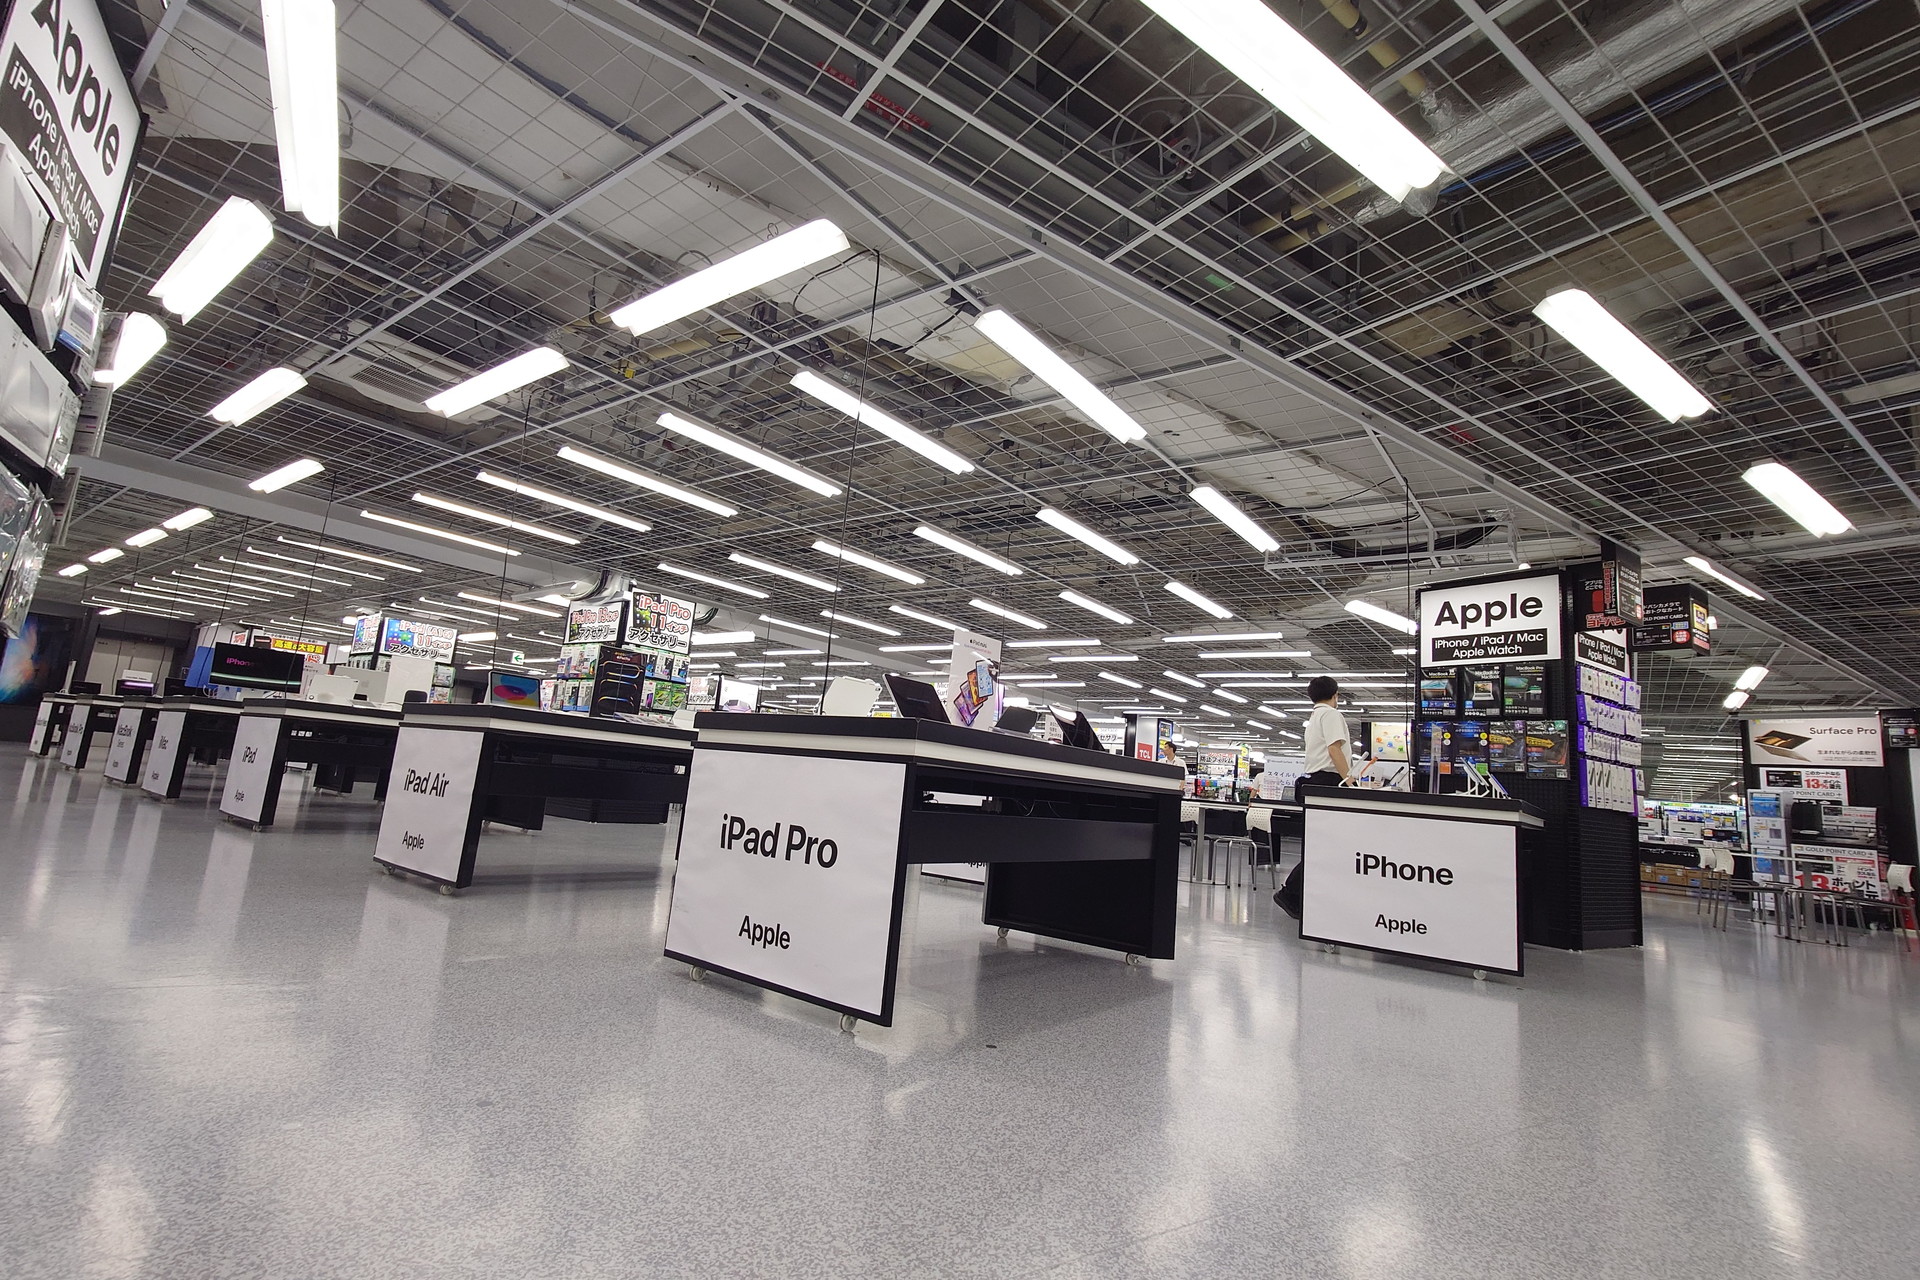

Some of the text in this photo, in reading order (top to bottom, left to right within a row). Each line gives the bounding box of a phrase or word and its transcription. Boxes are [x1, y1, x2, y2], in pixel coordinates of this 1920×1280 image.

[30, 0, 120, 177] Apple
[9, 60, 57, 143] iPhone
[60, 144, 77, 192] iPad
[80, 191, 98, 235] Mac
[28, 133, 80, 239] Apple Watch
[640, 595, 691, 620] iPad Pro
[1434, 593, 1543, 629] Apple
[400, 620, 425, 634] iPad
[579, 625, 616, 640] アクセサリー
[650, 613, 688, 634] 11インチ
[417, 634, 452, 649] 11インチ
[628, 627, 687, 649] アクセサリー
[1435, 639, 1469, 649] iPhone
[1480, 635, 1504, 645] iPad
[1517, 632, 1544, 642] Mac
[389, 642, 450, 659] アクセサリー
[1453, 645, 1522, 659] Apple Watch
[1588, 649, 1602, 661] Apple
[1809, 727, 1854, 735] Surface
[242, 745, 258, 764] iPad
[1139, 749, 1151, 759] TCL
[404, 768, 450, 797] iPad Air
[1804, 778, 1828, 790] 13%
[402, 830, 425, 850] Apple
[721, 813, 838, 868] iPad Pro
[1355, 852, 1454, 886] iPhone
[738, 915, 791, 949] Apple
[1375, 914, 1428, 935] Apple
